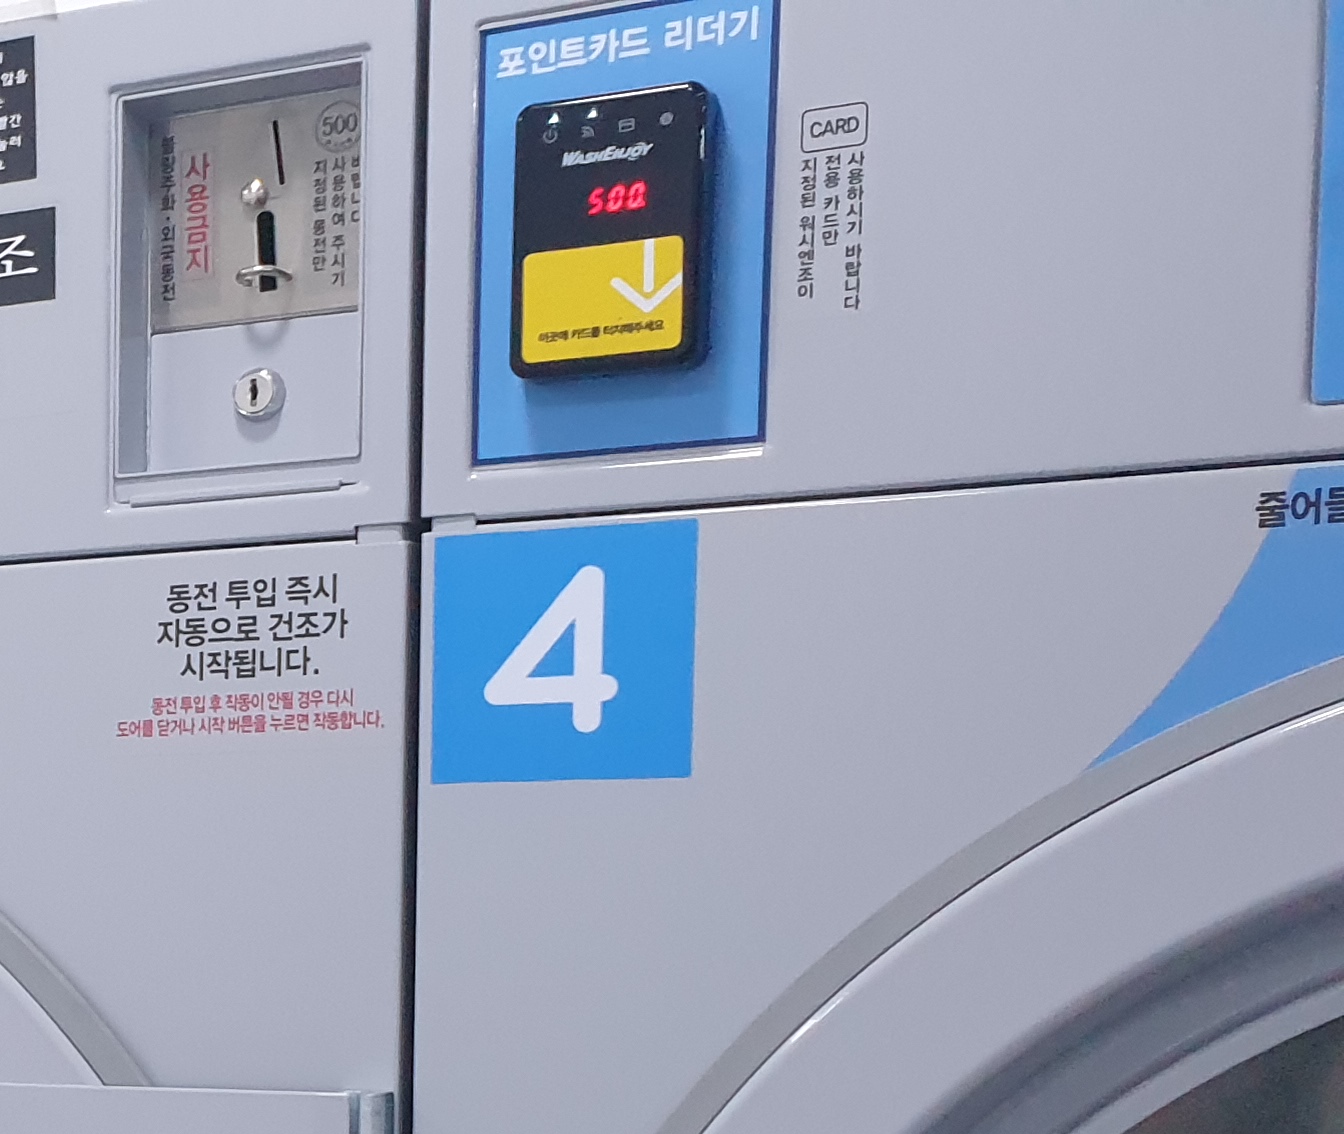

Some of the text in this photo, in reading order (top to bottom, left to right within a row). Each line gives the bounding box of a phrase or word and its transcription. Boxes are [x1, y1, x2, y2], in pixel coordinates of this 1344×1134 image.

[496, 5, 761, 80] 포인트카드 리더기
[322, 113, 358, 138] 500
[810, 116, 860, 138] CARD
[185, 152, 210, 274] 사용금지
[312, 159, 328, 273] 지정된 동전만
[331, 155, 347, 226] 사용하여
[822, 154, 841, 247] 전용 카드만
[330, 235, 346, 288] 주시기
[797, 157, 818, 299] 지정된 워시엔조이
[844, 151, 865, 310] 사용하시기 바랍니다
[157, 608, 349, 648] 자동으로 건조가
[167, 573, 338, 613] 동전 투입 즉시
[180, 646, 320, 681] 시작됩니다.
[483, 565, 619, 733] 4
[116, 709, 385, 738] 도어를 닫거나 시작 버튼을 누르면 작동합니다.
